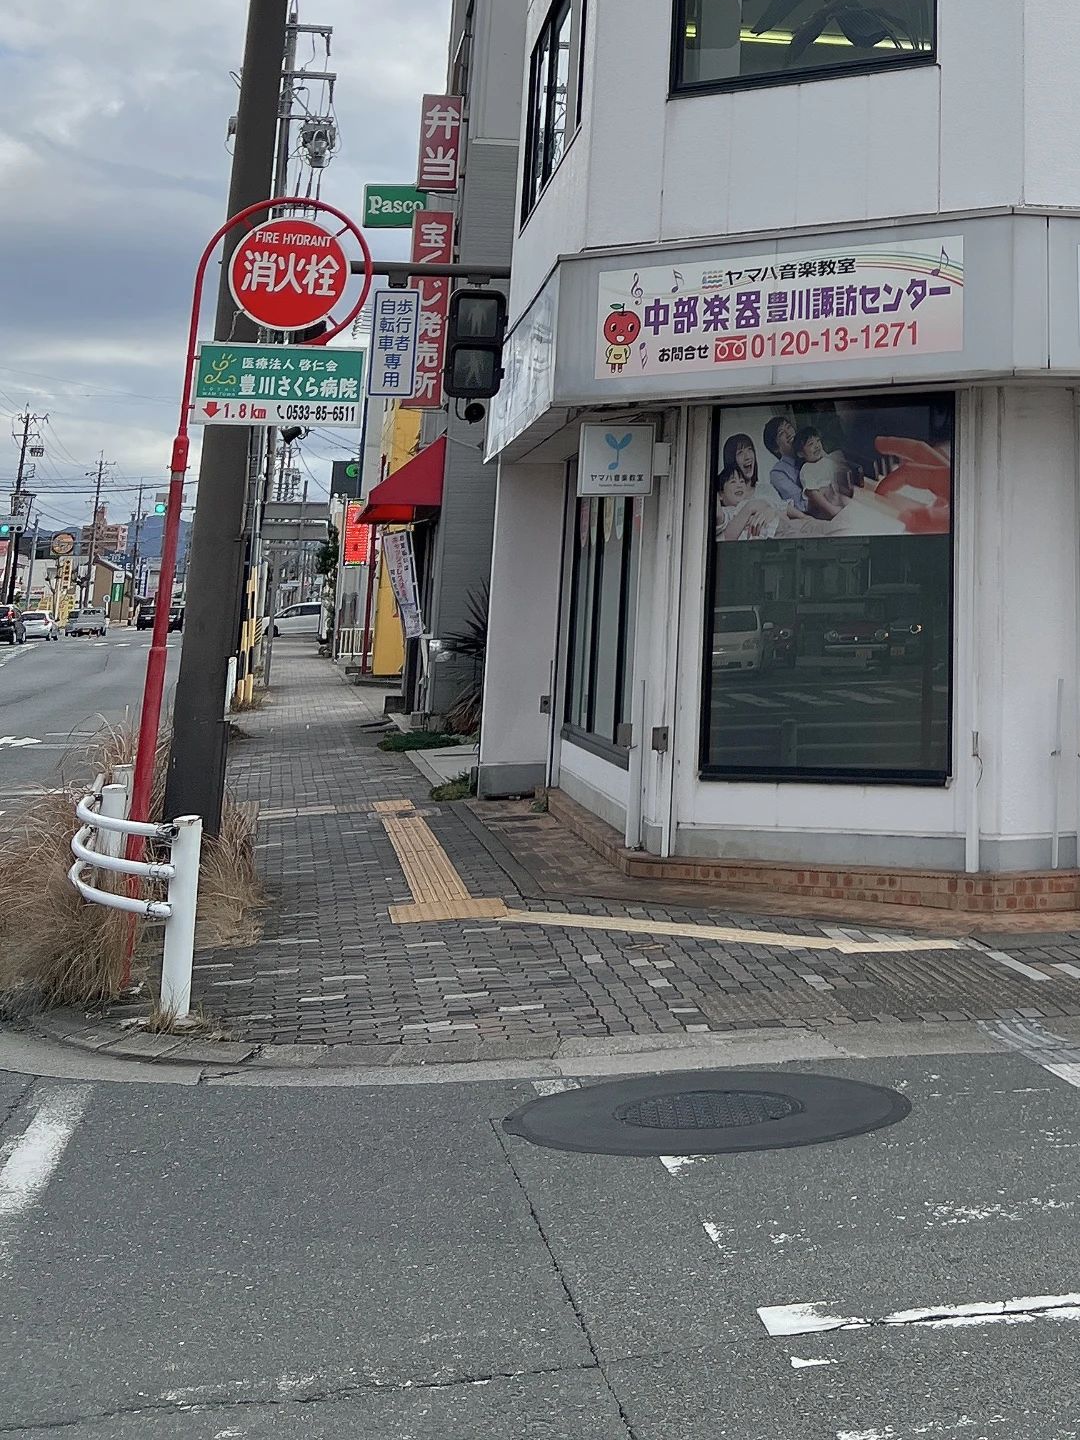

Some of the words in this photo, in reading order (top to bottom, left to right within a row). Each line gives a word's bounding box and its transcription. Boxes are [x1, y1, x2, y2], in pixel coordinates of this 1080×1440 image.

[421, 104, 460, 181] 弁当
[368, 194, 425, 214] Pasco
[255, 231, 279, 244] FIRE
[282, 233, 332, 248] HYDRANT
[241, 250, 339, 296] 消火栓
[725, 258, 857, 287] ヤマハ音楽教室
[644, 278, 951, 336] 中部楽器豊川諏訪センター
[658, 344, 709, 362] お問合せ
[751, 320, 919, 358] 0120-13-1271
[242, 356, 295, 371] 医療法人
[382, 353, 403, 389] 専用
[238, 373, 358, 399] 豊川さくら病院
[286, 404, 355, 422] 0533-85-6511
